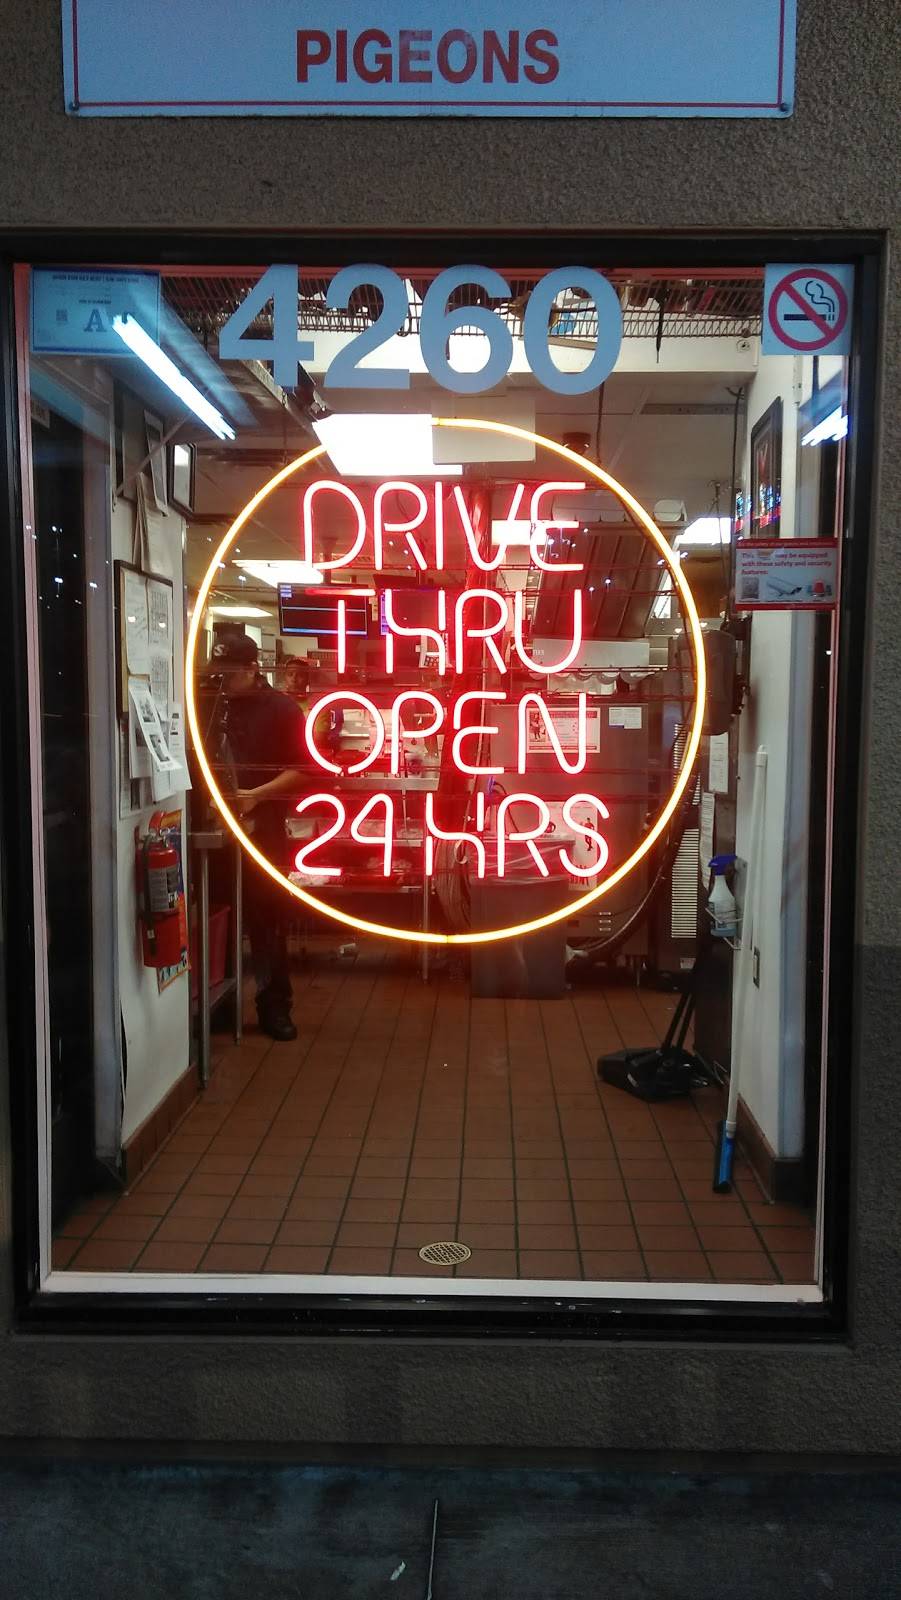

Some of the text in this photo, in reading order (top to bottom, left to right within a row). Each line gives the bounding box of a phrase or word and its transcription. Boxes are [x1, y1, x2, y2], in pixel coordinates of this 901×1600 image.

[297, 28, 561, 84] PIGEONS
[219, 264, 623, 395] 4260
[303, 480, 586, 571] DRIVE
[305, 588, 582, 675] THRU
[305, 691, 586, 774] OPEN
[295, 793, 393, 877] 24
[426, 792, 610, 878] HRS
